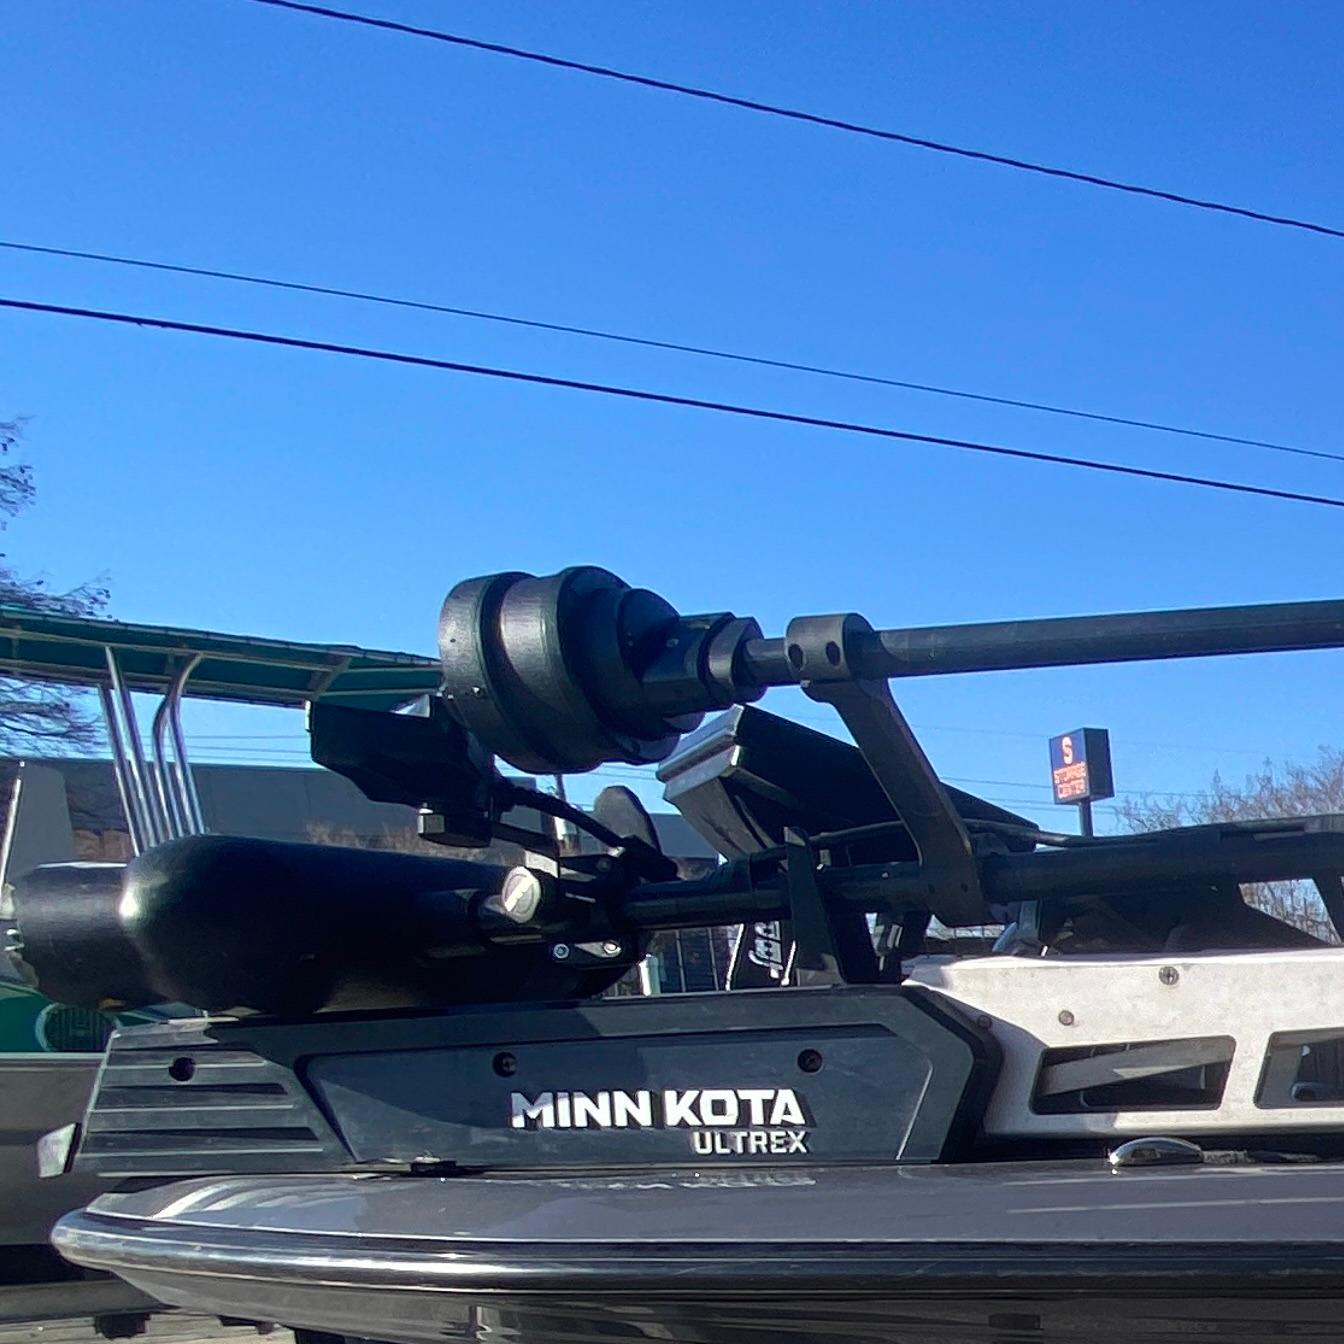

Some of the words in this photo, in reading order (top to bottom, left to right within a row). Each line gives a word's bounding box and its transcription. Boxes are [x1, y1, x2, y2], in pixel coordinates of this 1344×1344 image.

[1062, 736, 1073, 765] S
[511, 1090, 652, 1128] MINN
[664, 1088, 806, 1126] KOTA
[693, 1131, 807, 1154] ULTREX
